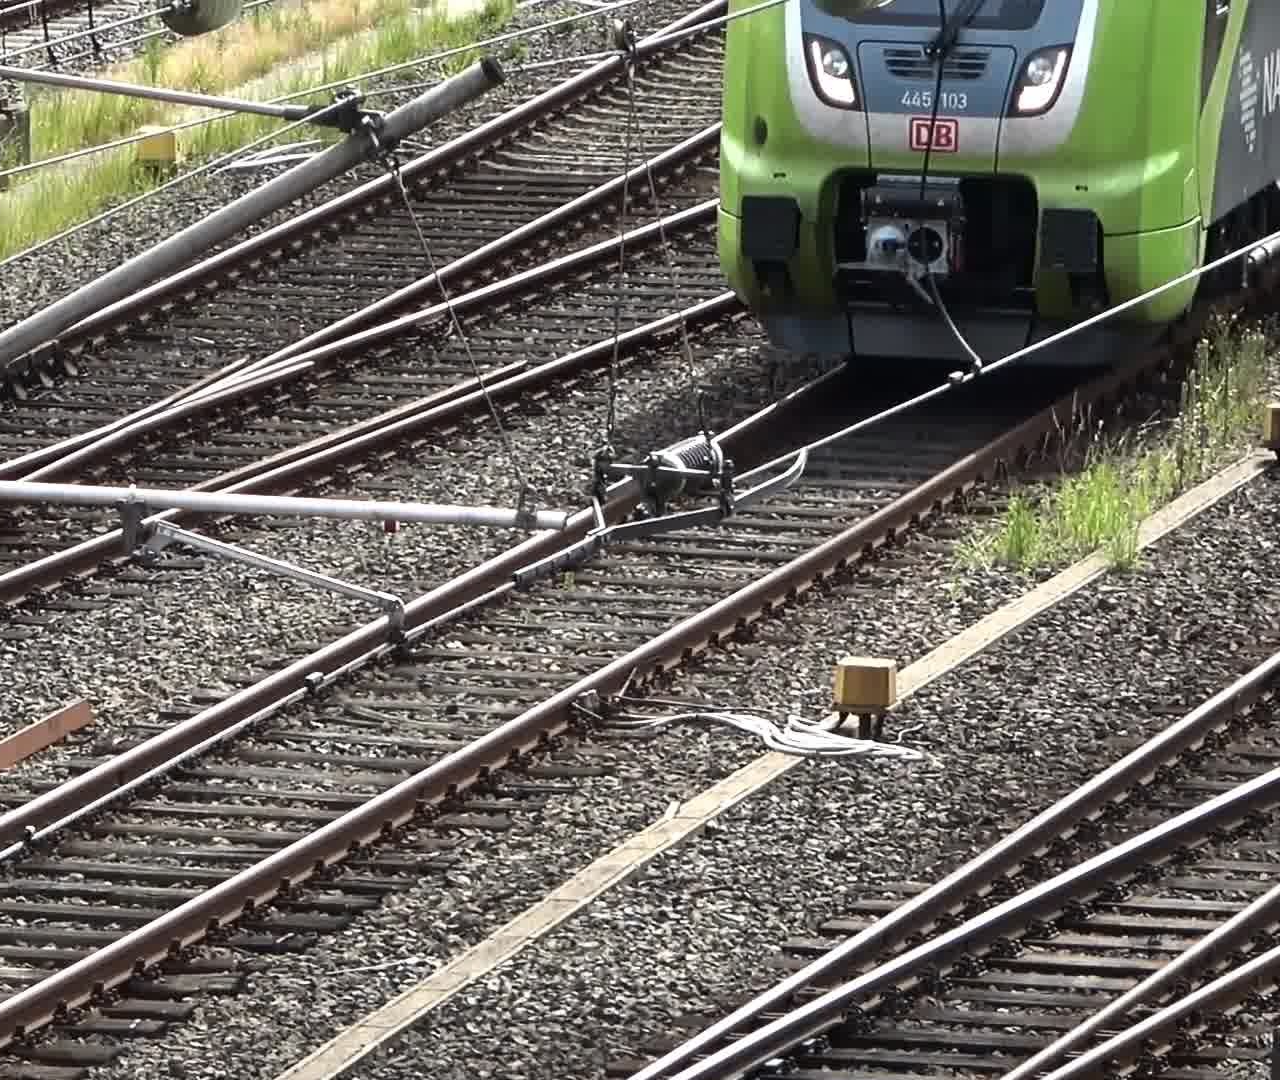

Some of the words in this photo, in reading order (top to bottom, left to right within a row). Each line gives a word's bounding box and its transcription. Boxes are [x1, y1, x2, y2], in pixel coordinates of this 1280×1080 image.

[901, 90, 931, 108] 445
[941, 92, 968, 109] 103
[915, 122, 954, 147] DB
